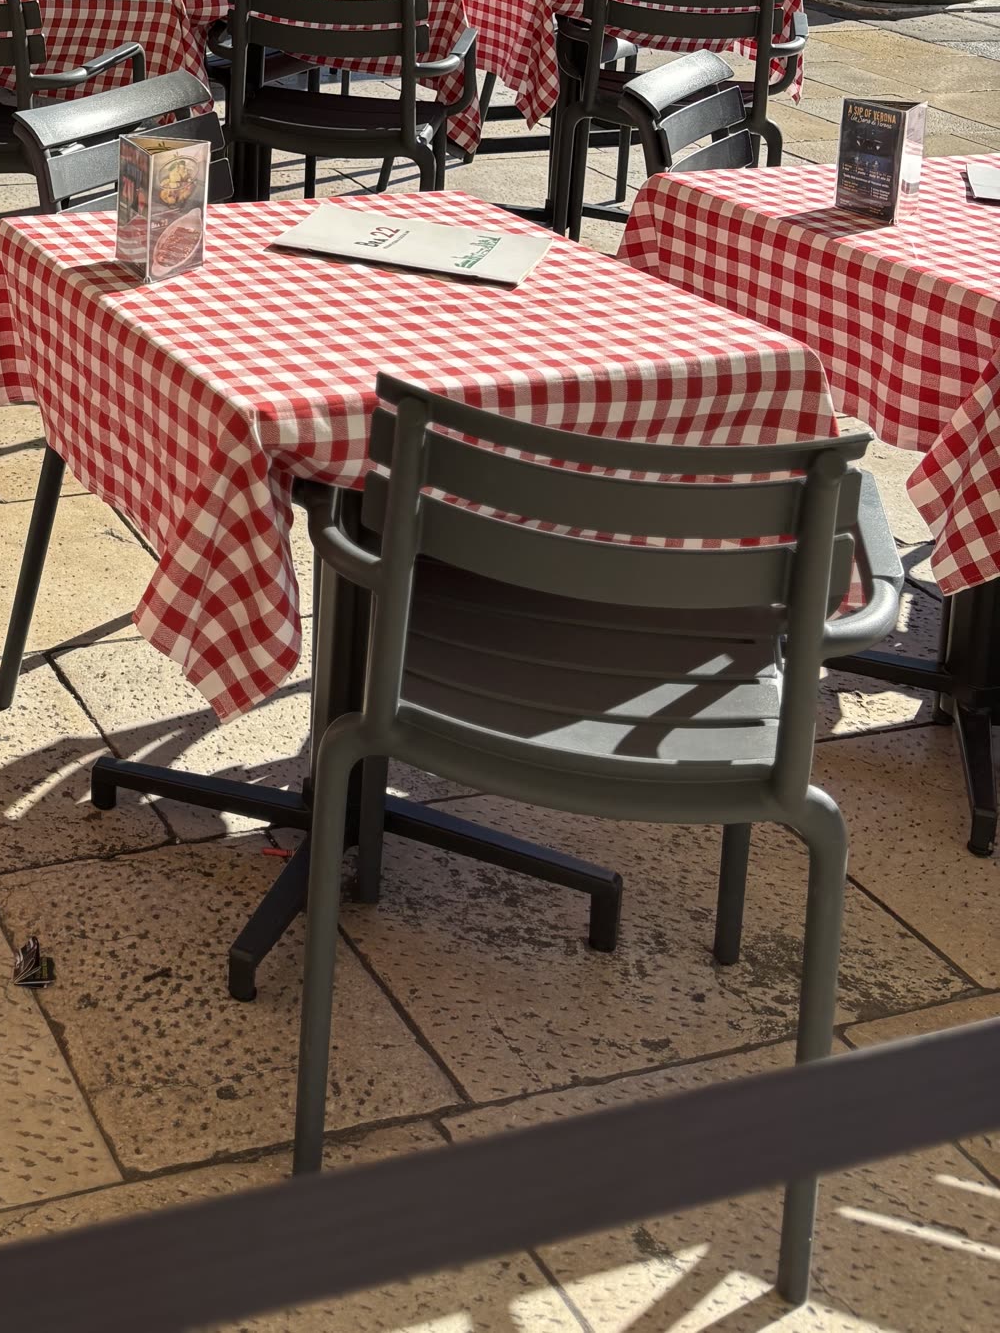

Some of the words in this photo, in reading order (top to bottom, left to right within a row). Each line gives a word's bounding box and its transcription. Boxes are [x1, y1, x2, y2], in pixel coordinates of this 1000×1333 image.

[854, 106, 863, 116] SIP
[864, 108, 872, 118] OF
[873, 110, 897, 124] VERONA
[370, 226, 401, 238] 22
